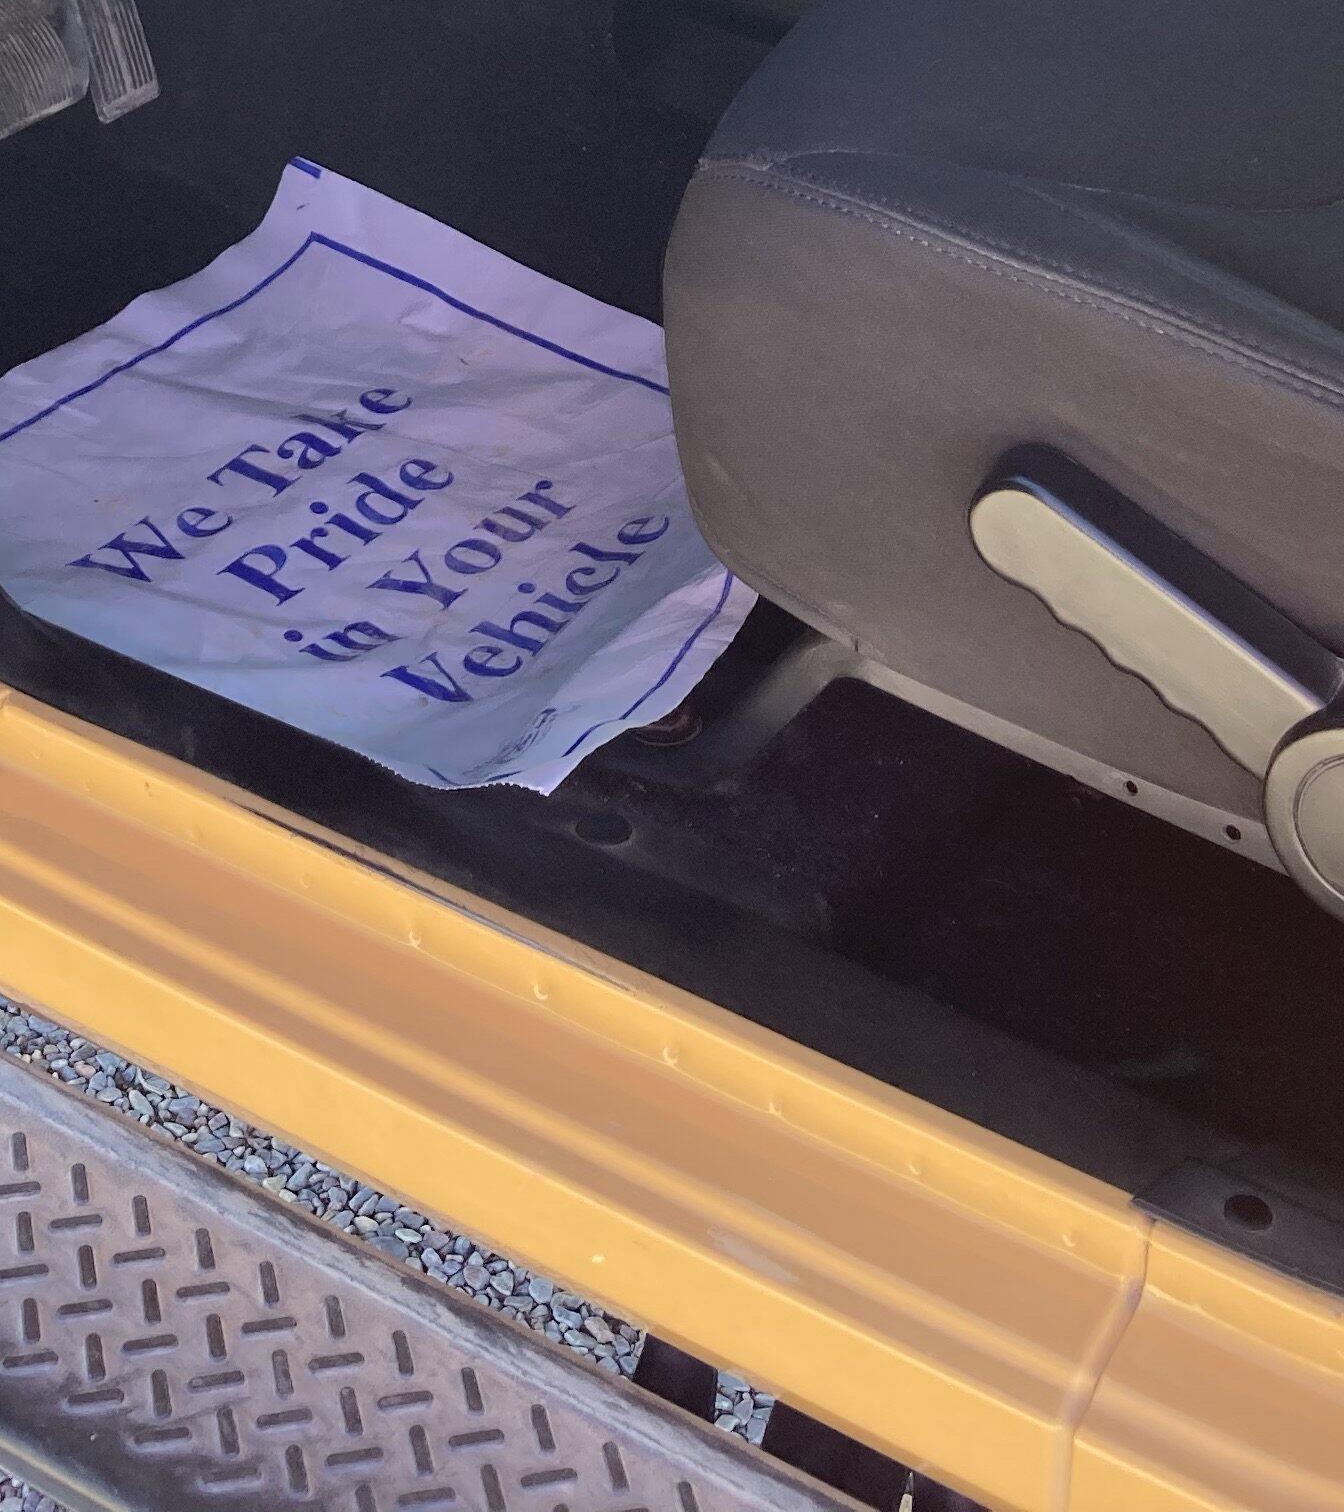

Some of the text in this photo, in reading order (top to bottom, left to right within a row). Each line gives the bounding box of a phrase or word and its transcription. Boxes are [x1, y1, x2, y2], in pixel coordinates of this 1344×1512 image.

[67, 384, 413, 583] We Take
[217, 457, 455, 607] Pride
[283, 480, 578, 663] in Your
[380, 512, 672, 703] Vehicle
